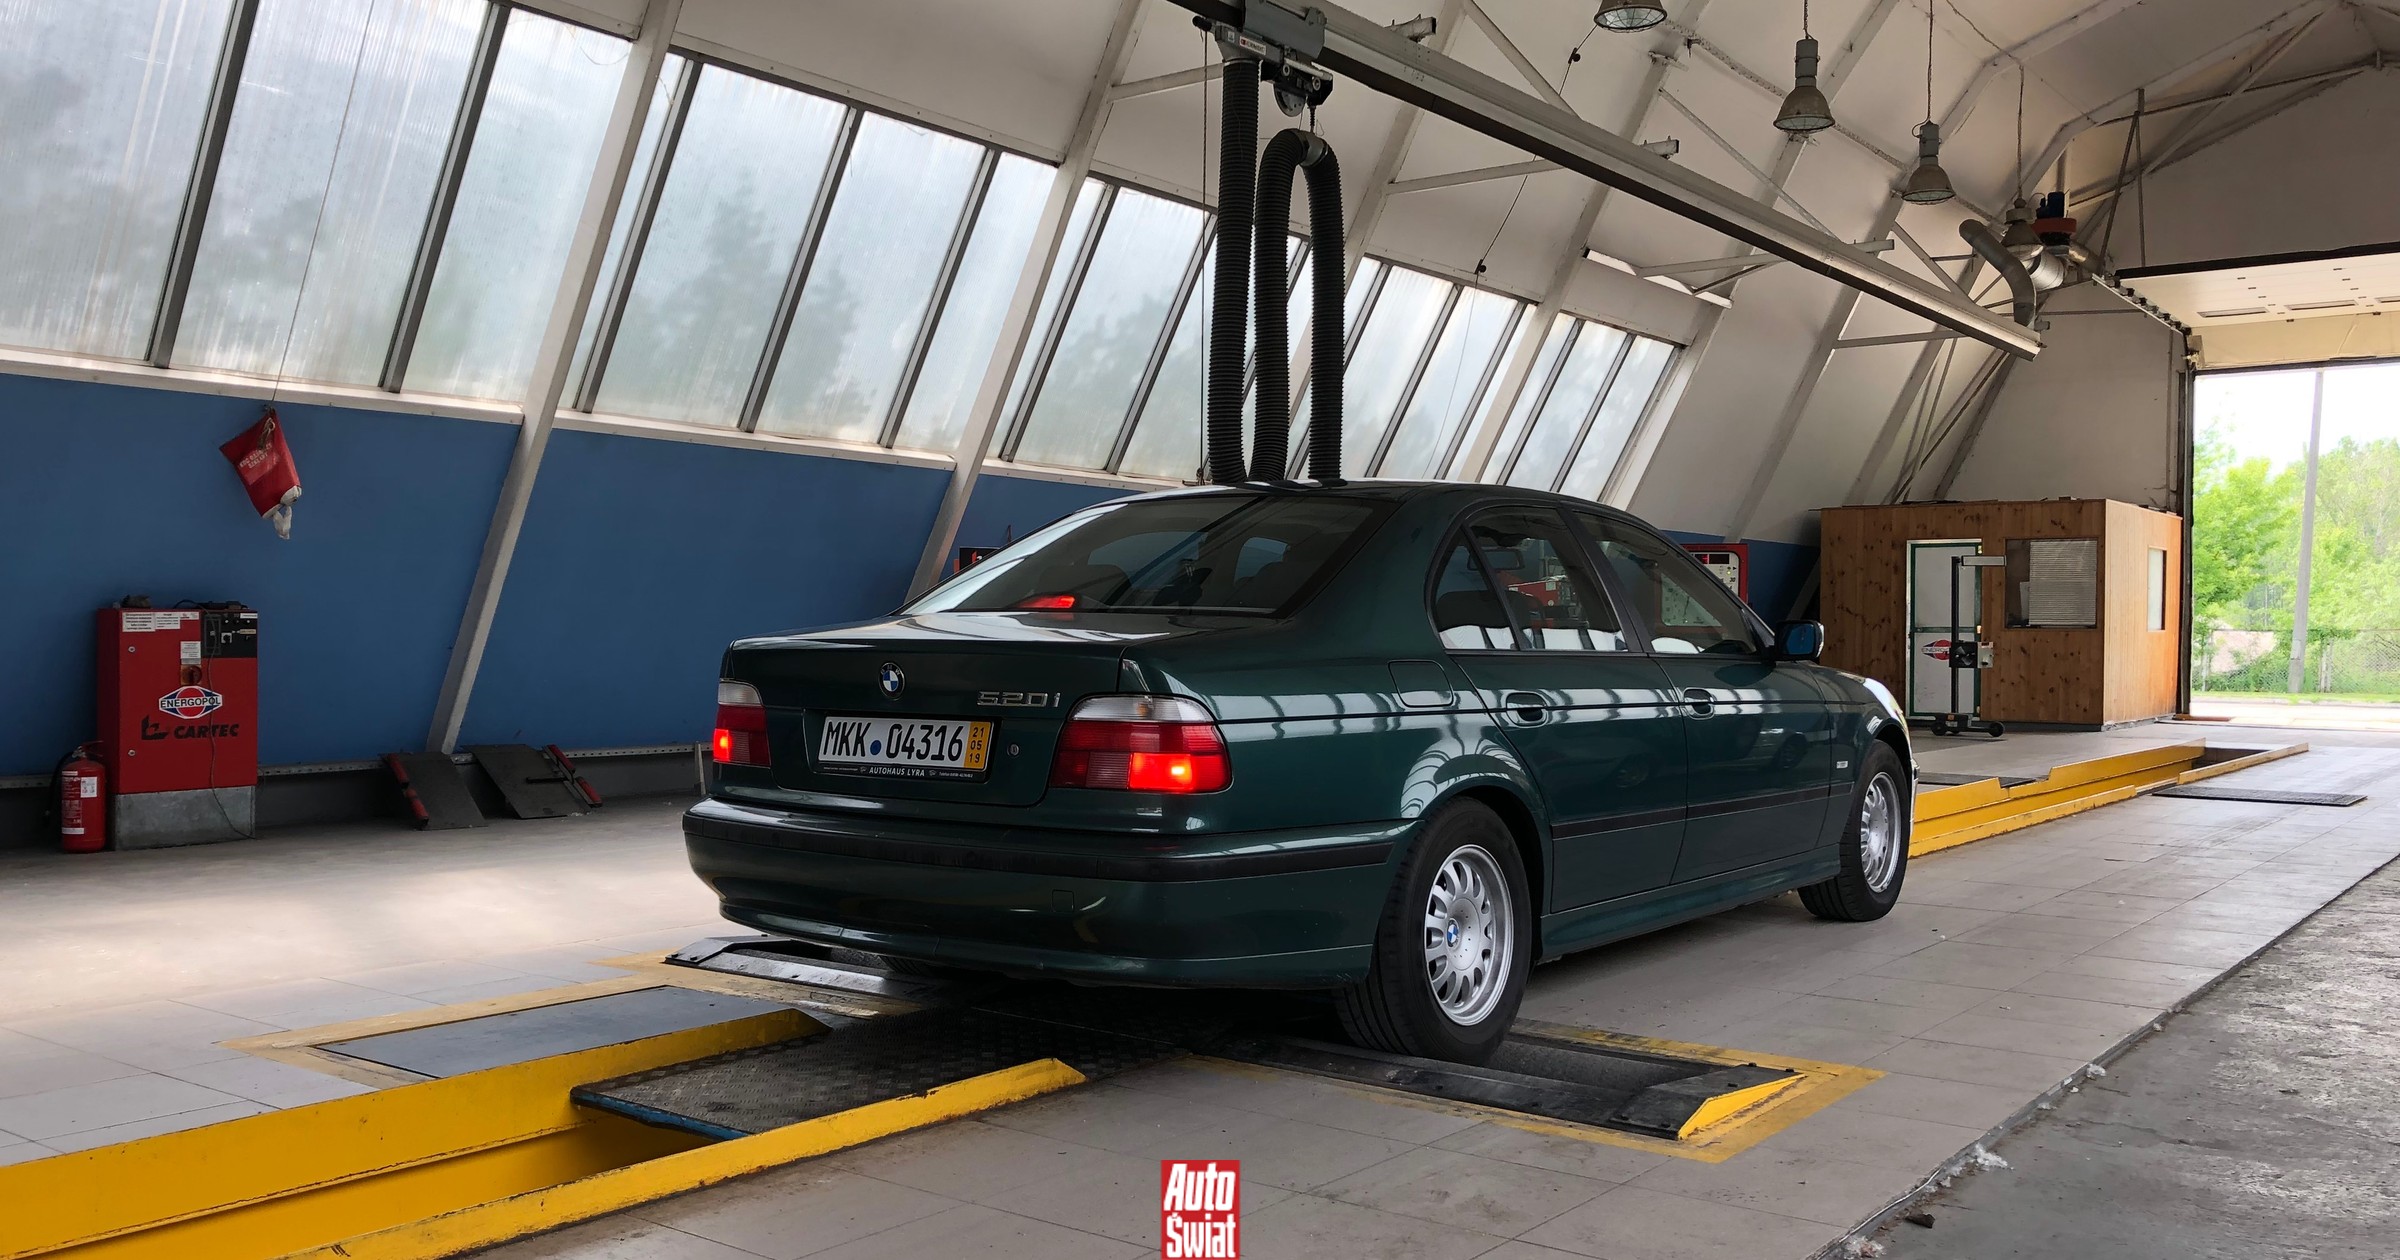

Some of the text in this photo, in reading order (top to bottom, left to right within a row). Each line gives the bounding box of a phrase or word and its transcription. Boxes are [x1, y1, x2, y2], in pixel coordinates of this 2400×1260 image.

[160, 696, 222, 709] ENERGOPOL
[976, 691, 1061, 708] 520i
[174, 723, 239, 739] CARTEC
[972, 726, 985, 738] 21
[823, 721, 964, 762] MKK 04316
[970, 739, 982, 751] 05
[968, 752, 980, 764] 19
[869, 766, 905, 776] AUTOHAUS
[907, 768, 925, 777] LYRA
